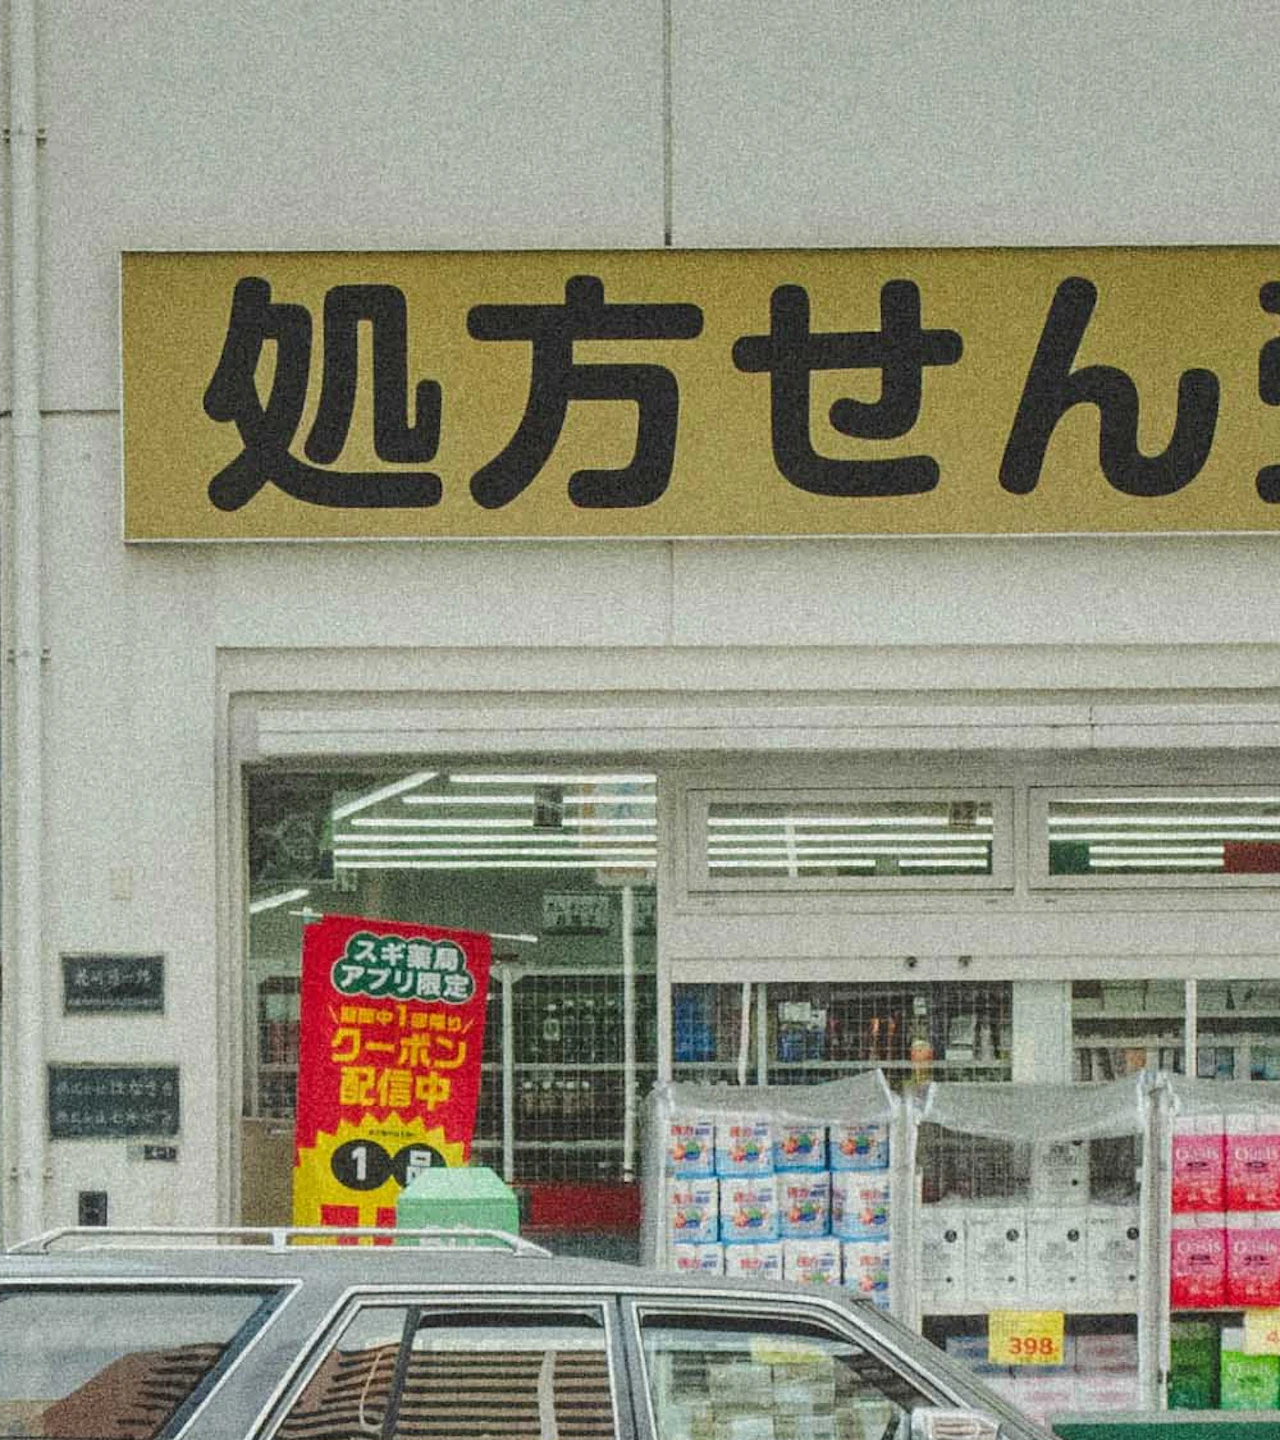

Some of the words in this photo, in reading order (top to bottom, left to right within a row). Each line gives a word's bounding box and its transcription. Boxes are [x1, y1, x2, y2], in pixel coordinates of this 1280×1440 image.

[354, 940, 459, 971] スギ薬局
[340, 964, 470, 998] アプリ限定
[331, 1028, 467, 1070] クーポン
[339, 1066, 453, 1112] 配信中
[1009, 1337, 1054, 1356] 398
